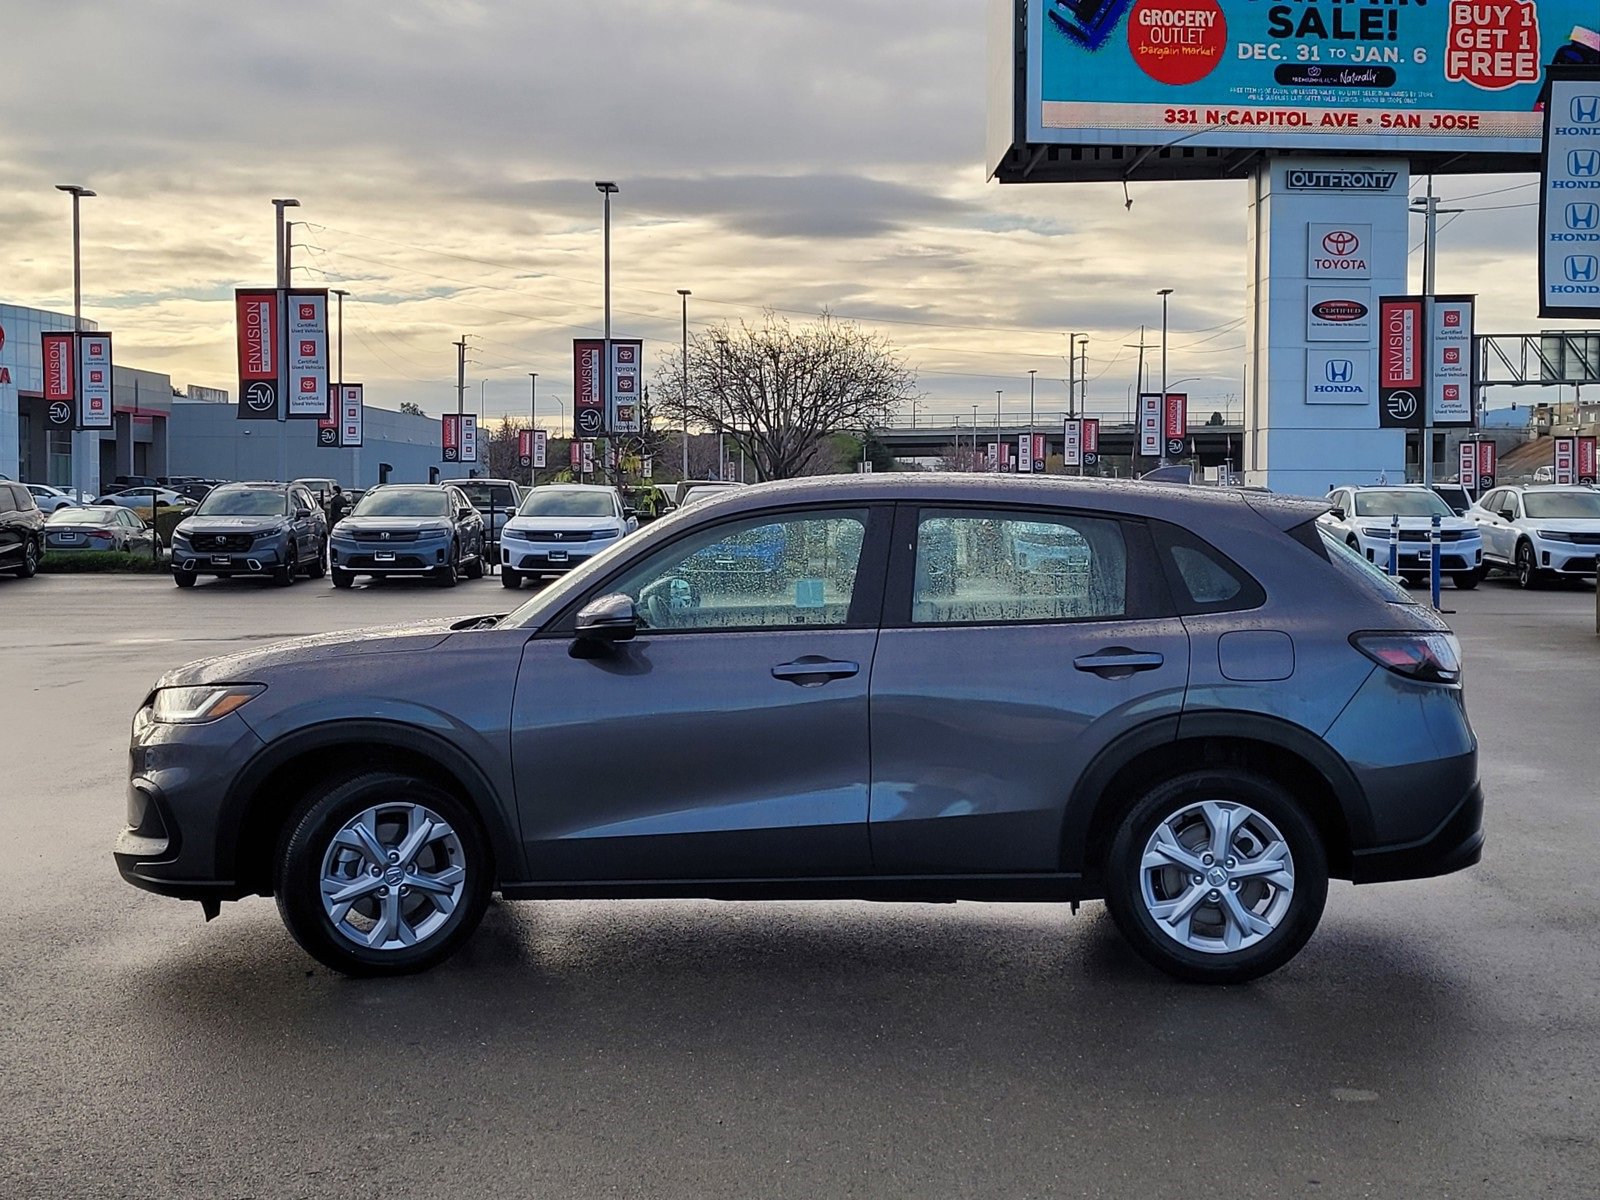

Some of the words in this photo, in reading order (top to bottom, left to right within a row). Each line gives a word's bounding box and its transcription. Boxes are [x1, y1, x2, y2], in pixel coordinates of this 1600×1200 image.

[1139, 9, 1216, 27] GROCERY
[1267, 5, 1398, 41] SALE!
[1455, 5, 1511, 26] BUY
[1520, 6, 1532, 26] 1
[1150, 28, 1206, 44] OUTLET
[1456, 28, 1508, 49] GET
[1519, 30, 1530, 50] 1
[1138, 41, 1180, 59] bargain
[1182, 46, 1216, 56] market
[1238, 43, 1288, 60] DEC.
[1296, 44, 1320, 61] 31
[1329, 48, 1346, 58] TO
[1351, 46, 1405, 63] JAN.
[1413, 48, 1428, 64] 6
[1450, 51, 1534, 78] FREE
[1340, 69, 1377, 84] Naturally
[1164, 108, 1198, 124] 331
[1226, 110, 1313, 127] CAPITOL
[1320, 112, 1359, 128] AVE
[1380, 114, 1425, 129] SAN
[1429, 114, 1480, 130] JOSE
[1552, 180, 1600, 189] HOND
[1550, 234, 1600, 242] HOND
[1314, 259, 1366, 270] TOYOTA
[1550, 285, 1600, 294] HOND
[246, 302, 261, 372] ENVISION
[1390, 309, 1403, 380] ENVISION
[50, 342, 60, 394] ENVISION
[582, 349, 591, 402] ENVISION
